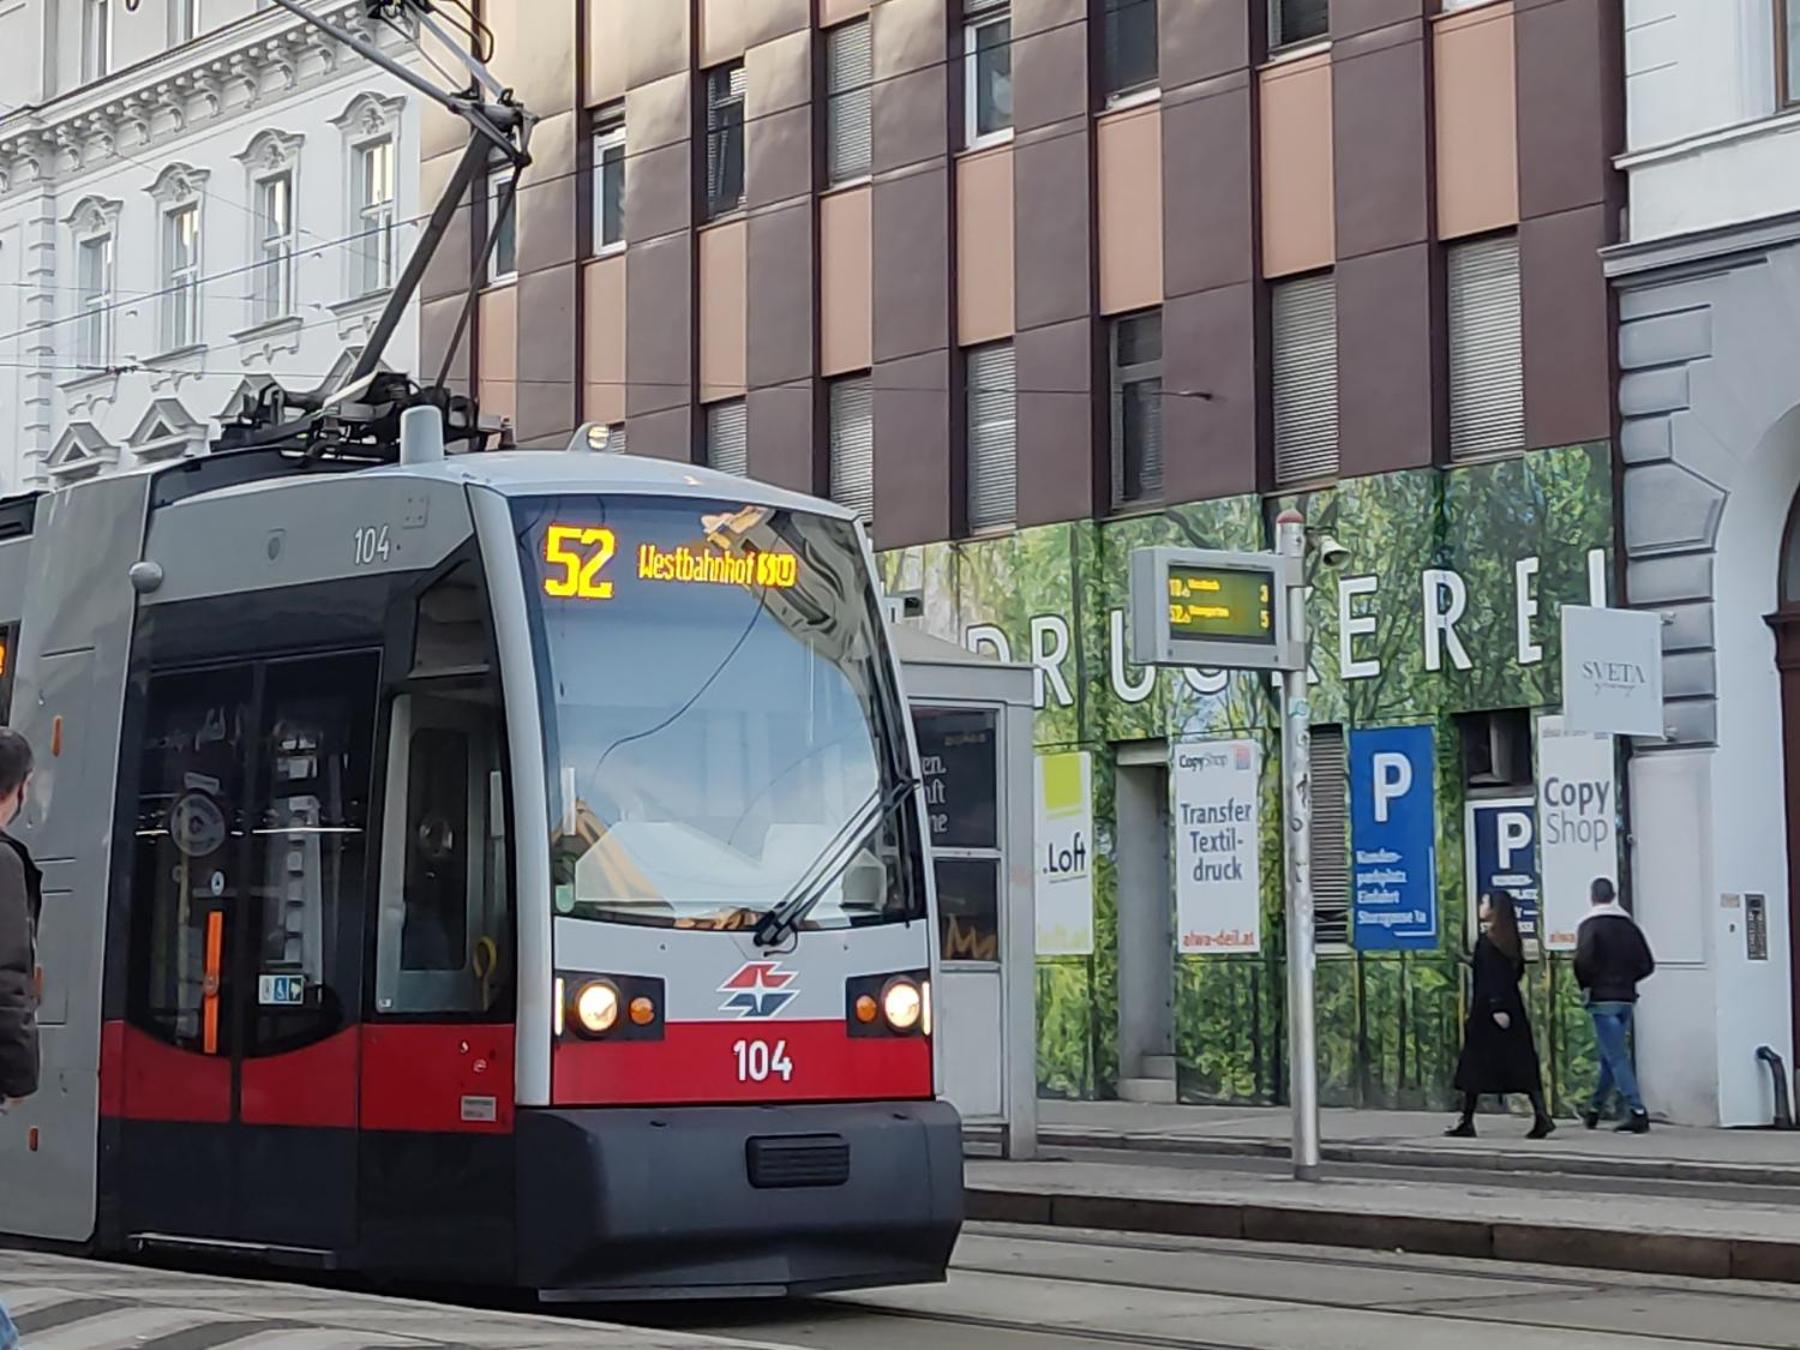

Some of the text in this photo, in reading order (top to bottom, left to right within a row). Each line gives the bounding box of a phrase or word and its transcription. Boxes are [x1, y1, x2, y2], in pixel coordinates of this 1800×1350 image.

[354, 525, 390, 564] 104
[544, 525, 615, 598] 52
[638, 545, 753, 585] Westbahnhof
[1373, 752, 1413, 823] P
[1543, 776, 1610, 816] Copy
[1180, 796, 1252, 826] Transfer
[1189, 828, 1244, 853] Textil-
[1497, 812, 1533, 870] P
[1546, 812, 1609, 852] Shop
[1192, 856, 1243, 881] druck
[733, 1039, 793, 1082] 104
